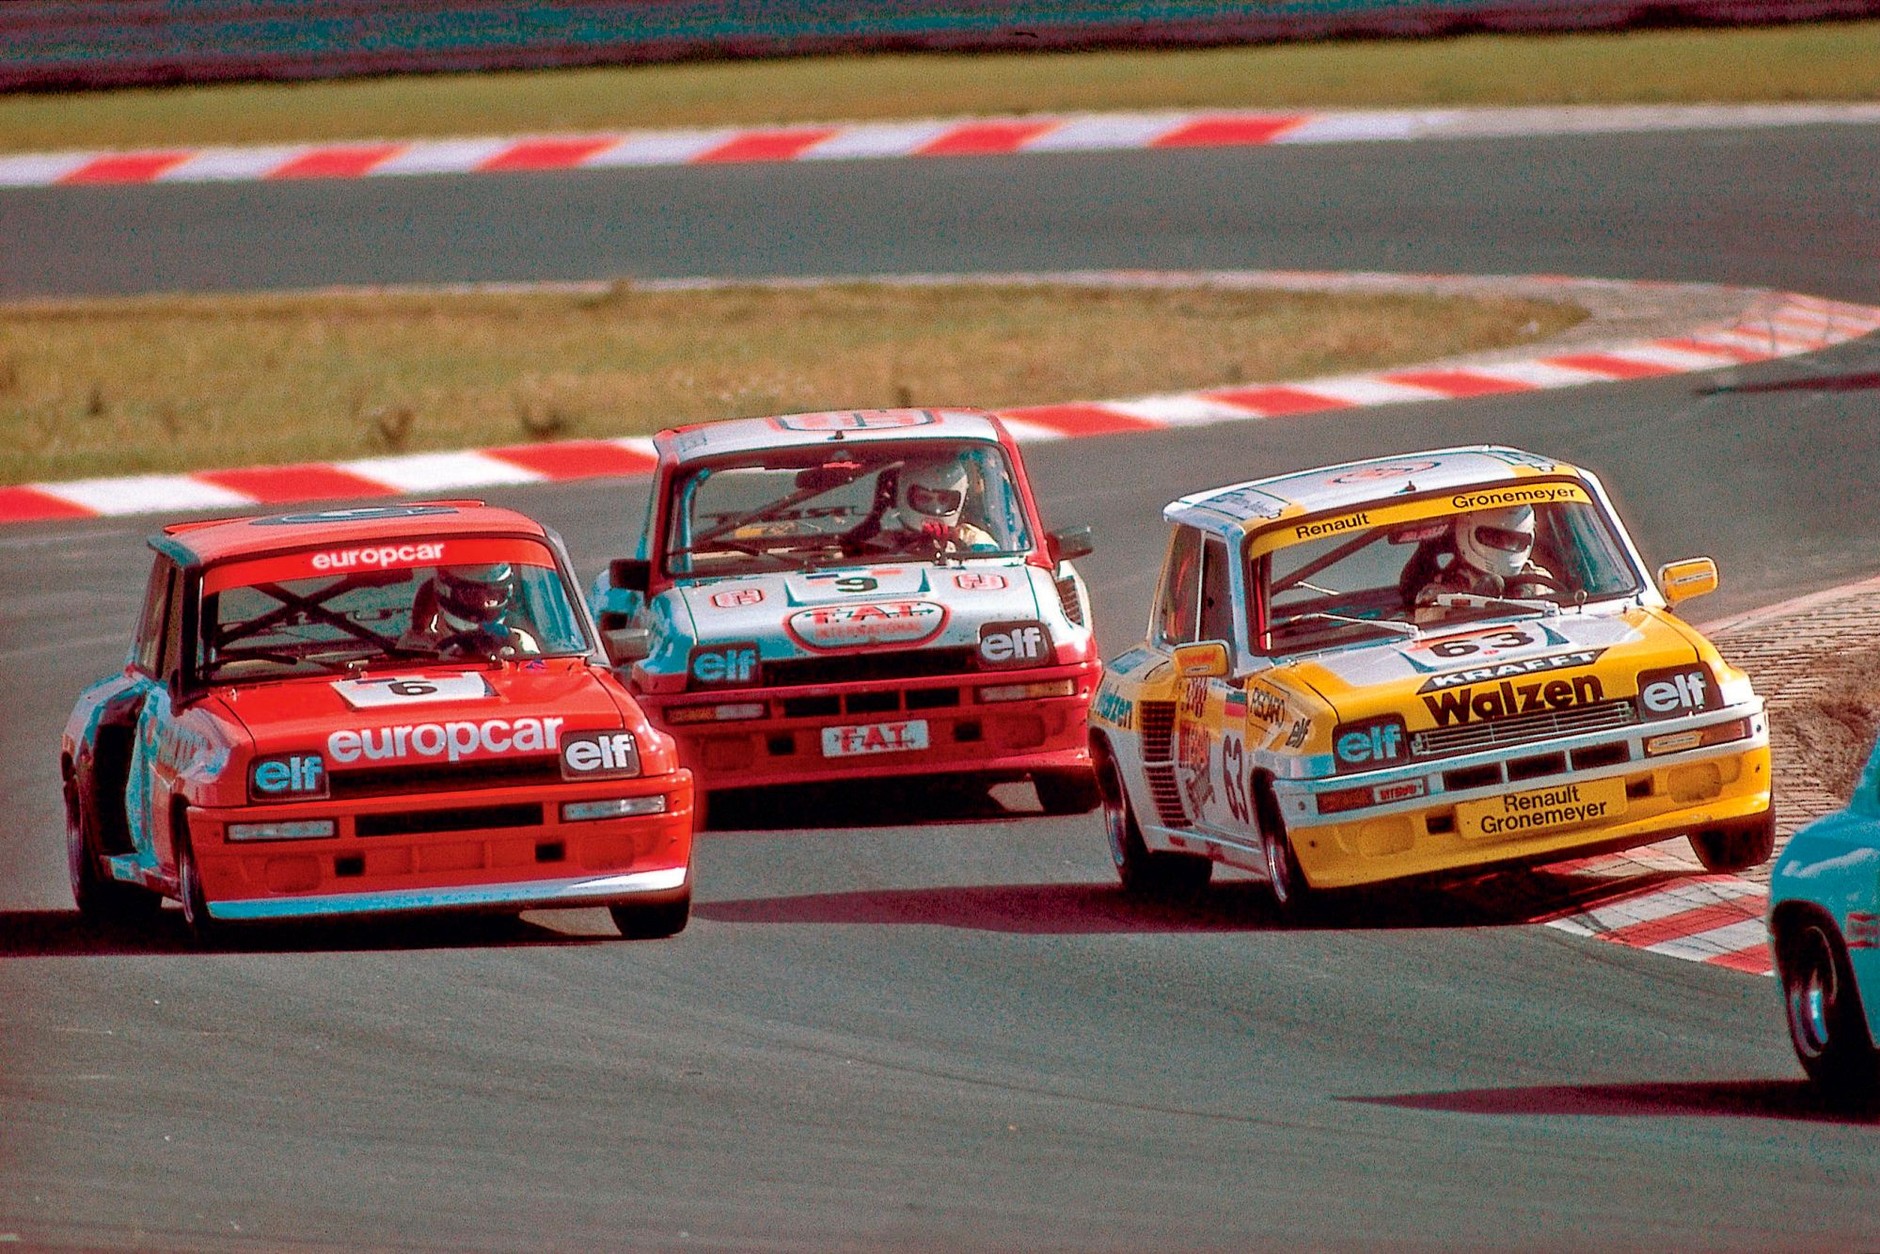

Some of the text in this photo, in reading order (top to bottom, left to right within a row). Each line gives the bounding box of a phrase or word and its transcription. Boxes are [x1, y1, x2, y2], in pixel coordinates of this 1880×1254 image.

[1296, 513, 1370, 538] Renault
[1452, 487, 1576, 509] Gronemeyer
[312, 543, 445, 569] europcar
[981, 627, 1041, 660] elf
[1429, 631, 1534, 658] 63
[694, 649, 757, 681] elf
[1432, 650, 1596, 687] KRAFFT
[388, 680, 438, 697] 6
[1422, 674, 1604, 728] Walzen
[1643, 671, 1707, 712] elf
[327, 716, 564, 764] europcar
[565, 735, 632, 771] elf
[1337, 724, 1401, 763] elf
[254, 755, 322, 792] elf
[1503, 785, 1580, 812] Renault
[1480, 800, 1608, 834] Gronemeyer
